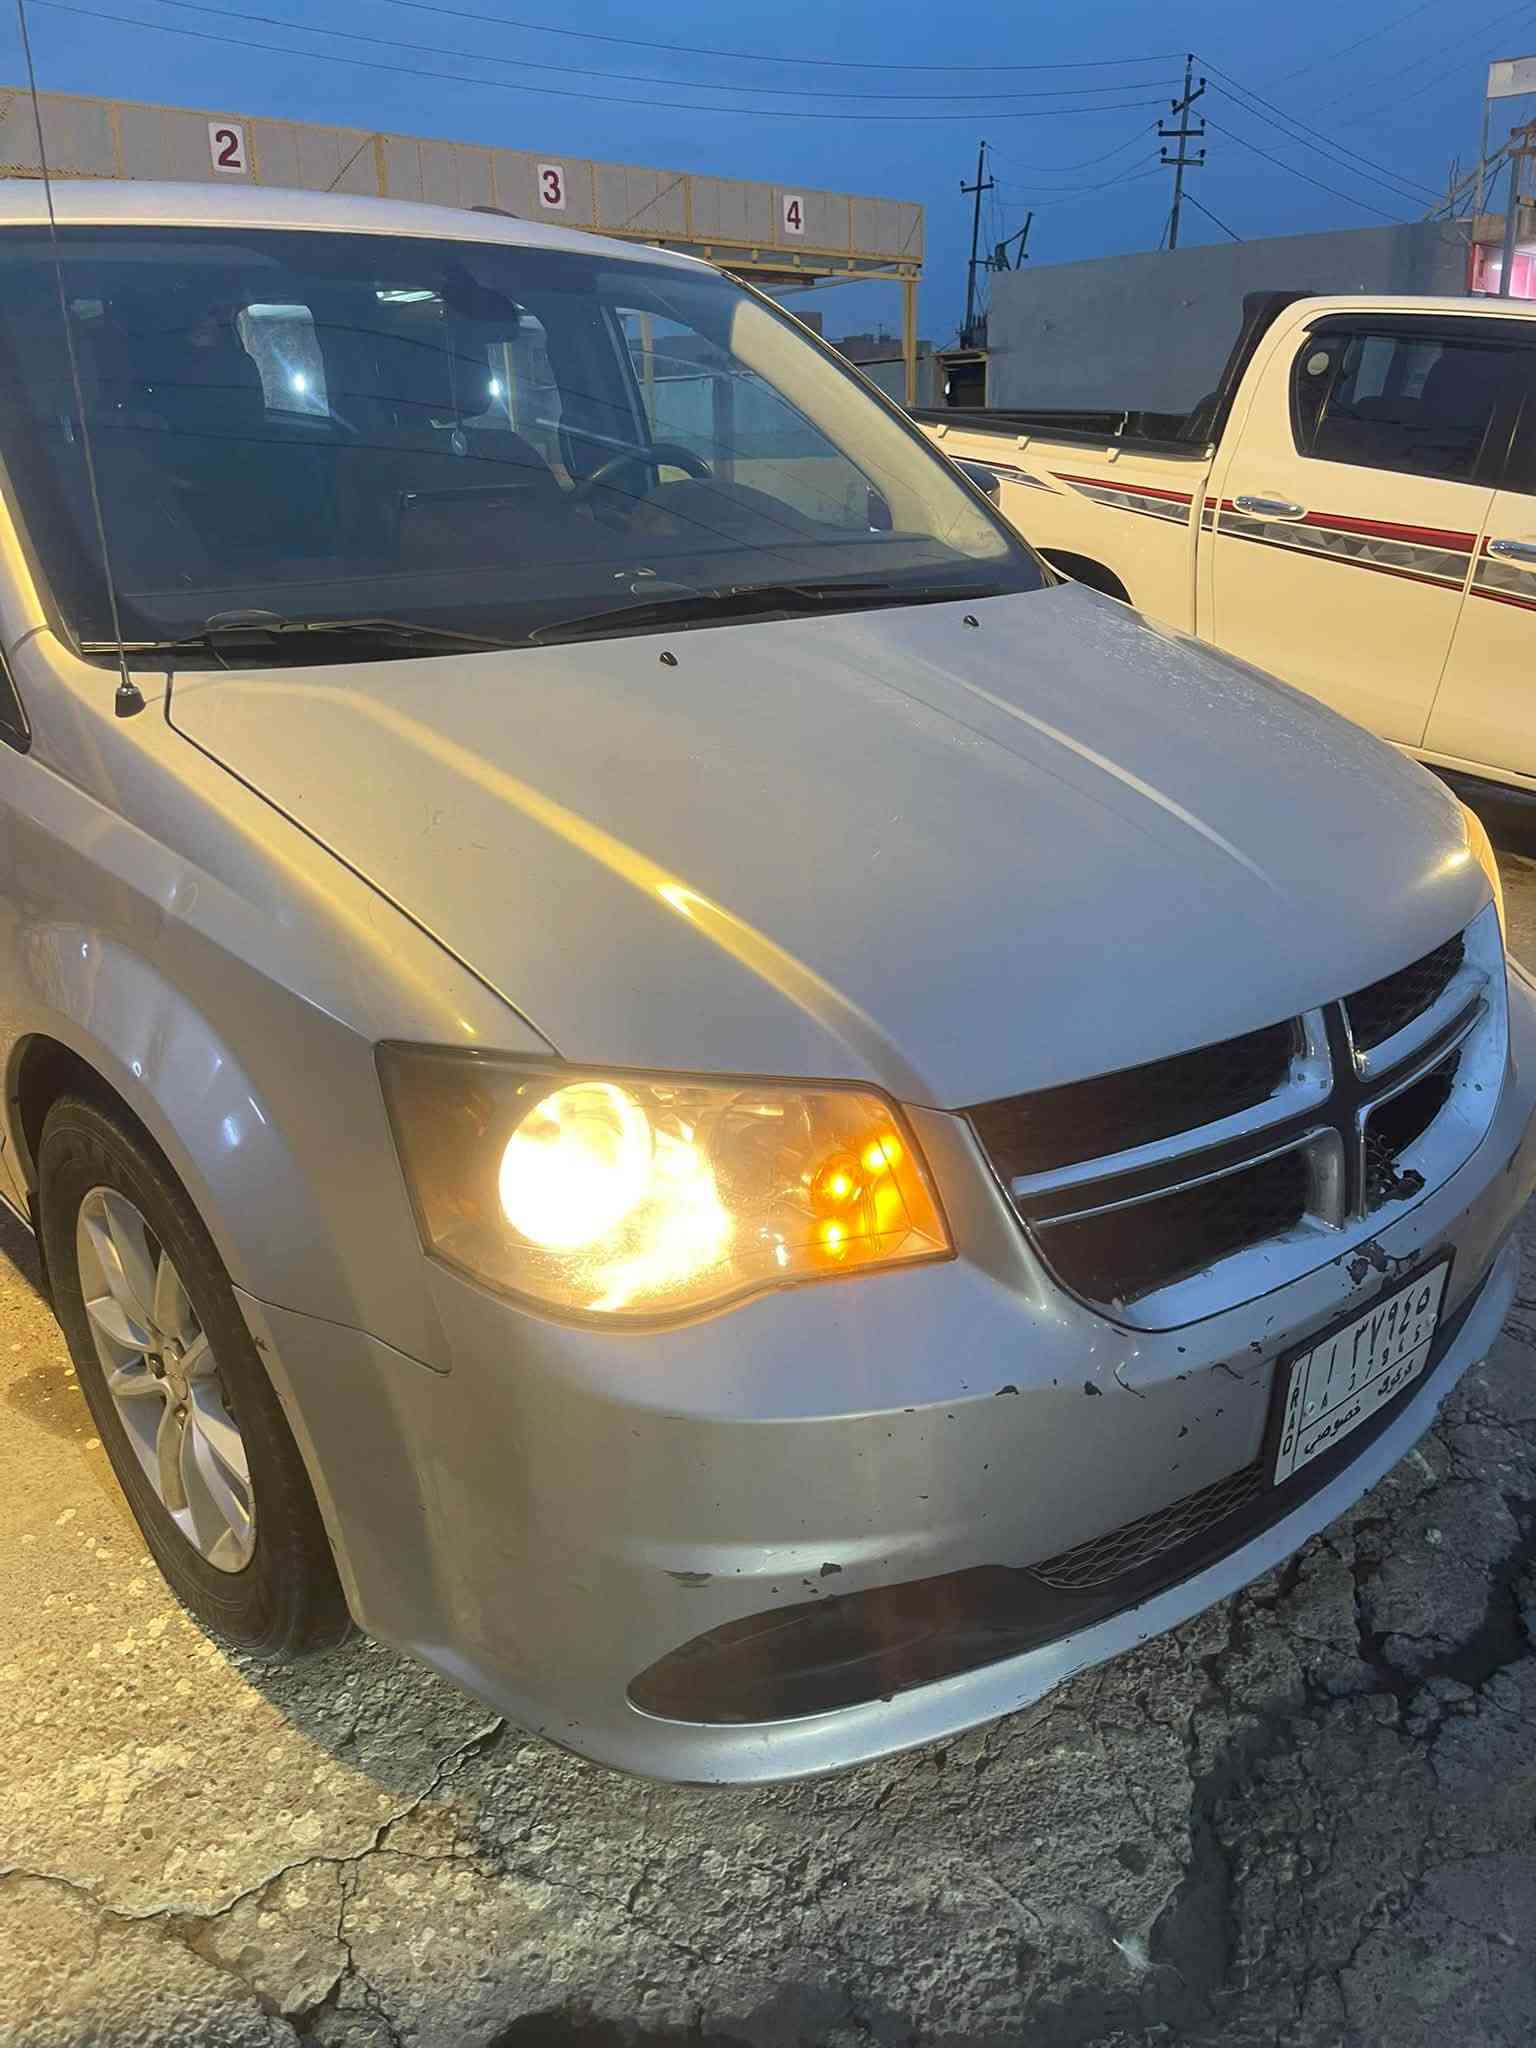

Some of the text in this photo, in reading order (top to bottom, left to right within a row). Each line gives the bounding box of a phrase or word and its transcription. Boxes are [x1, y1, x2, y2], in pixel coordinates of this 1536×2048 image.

[215, 129, 241, 168] 2
[543, 171, 561, 203] 3
[786, 201, 802, 230] 4
